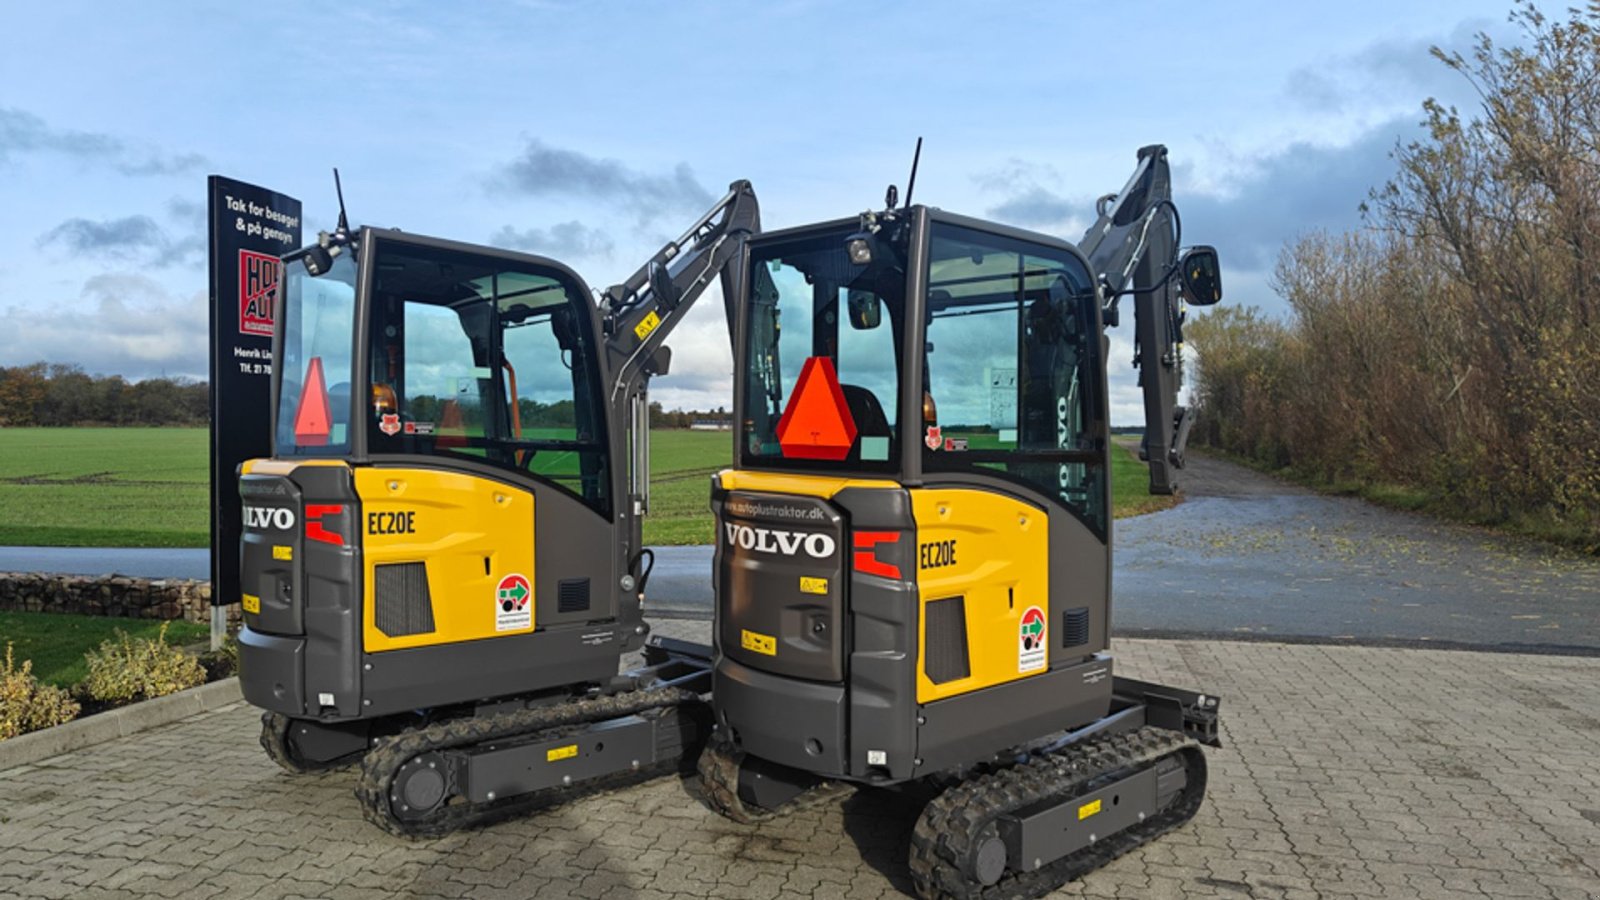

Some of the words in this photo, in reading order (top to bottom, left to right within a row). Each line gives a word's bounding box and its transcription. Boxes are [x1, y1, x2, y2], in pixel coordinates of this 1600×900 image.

[225, 195, 247, 213] Tak
[248, 201, 264, 217] for
[266, 205, 299, 228] besøget
[235, 217, 246, 232] &
[247, 219, 262, 237] på
[263, 226, 293, 244] gensyn
[234, 346, 261, 359] Henrik
[368, 511, 415, 535] EC20E
[725, 521, 835, 559] VOLVO
[920, 539, 957, 570] EC20E
